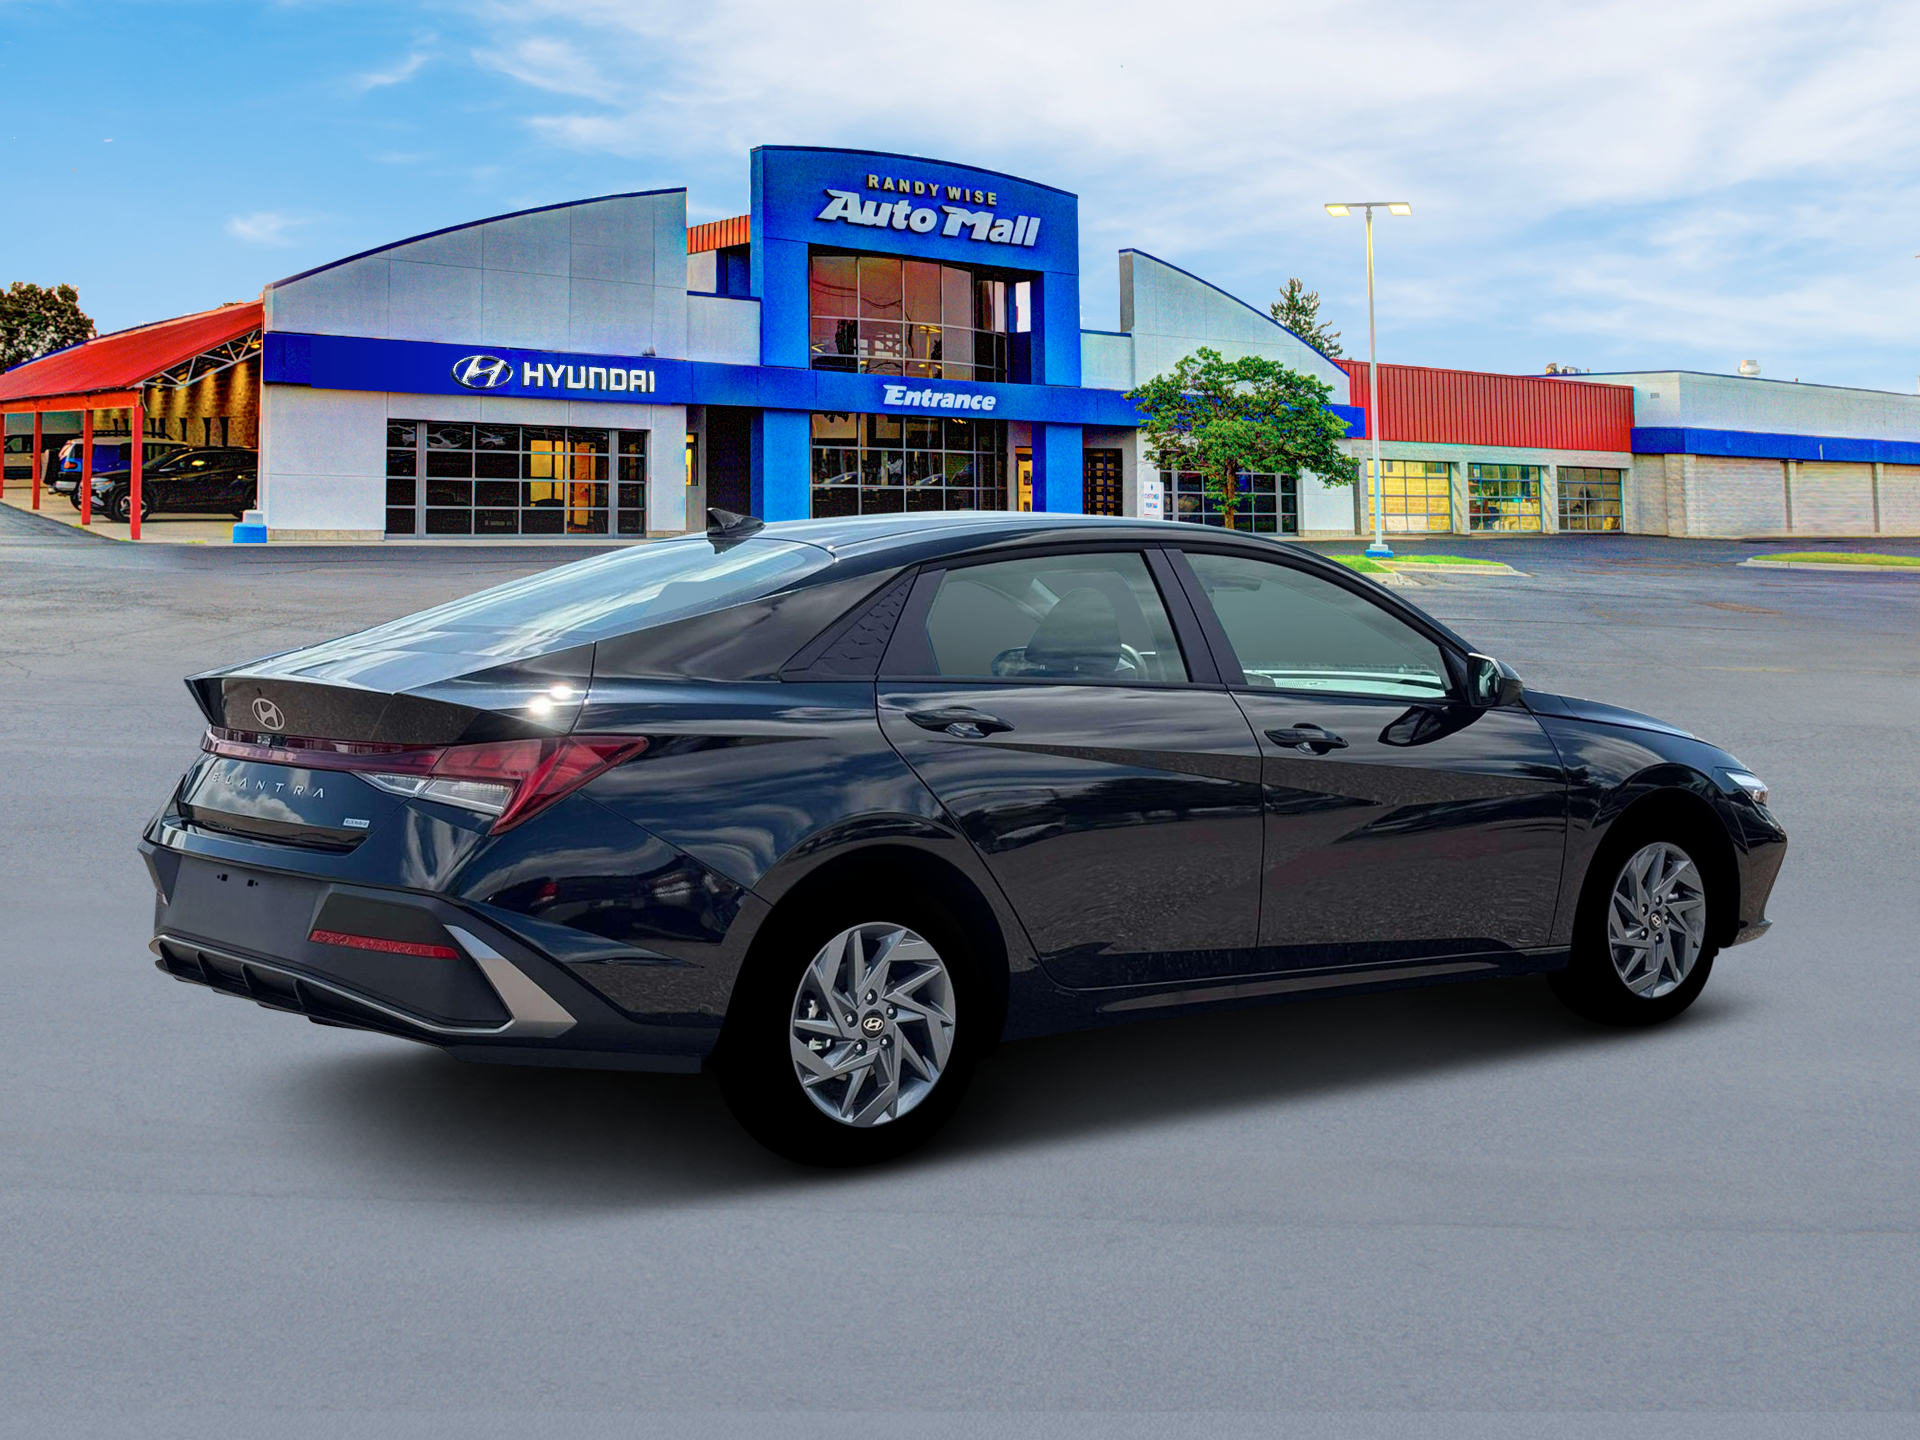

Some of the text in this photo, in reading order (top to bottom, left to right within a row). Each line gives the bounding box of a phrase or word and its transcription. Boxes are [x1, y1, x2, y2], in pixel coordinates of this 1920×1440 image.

[867, 174, 997, 206] RANDY WISE
[815, 189, 1041, 247] Auto Mall
[521, 361, 656, 393] HYUNDAI
[882, 384, 997, 411] Entrance
[212, 772, 324, 798] ELANTRA
